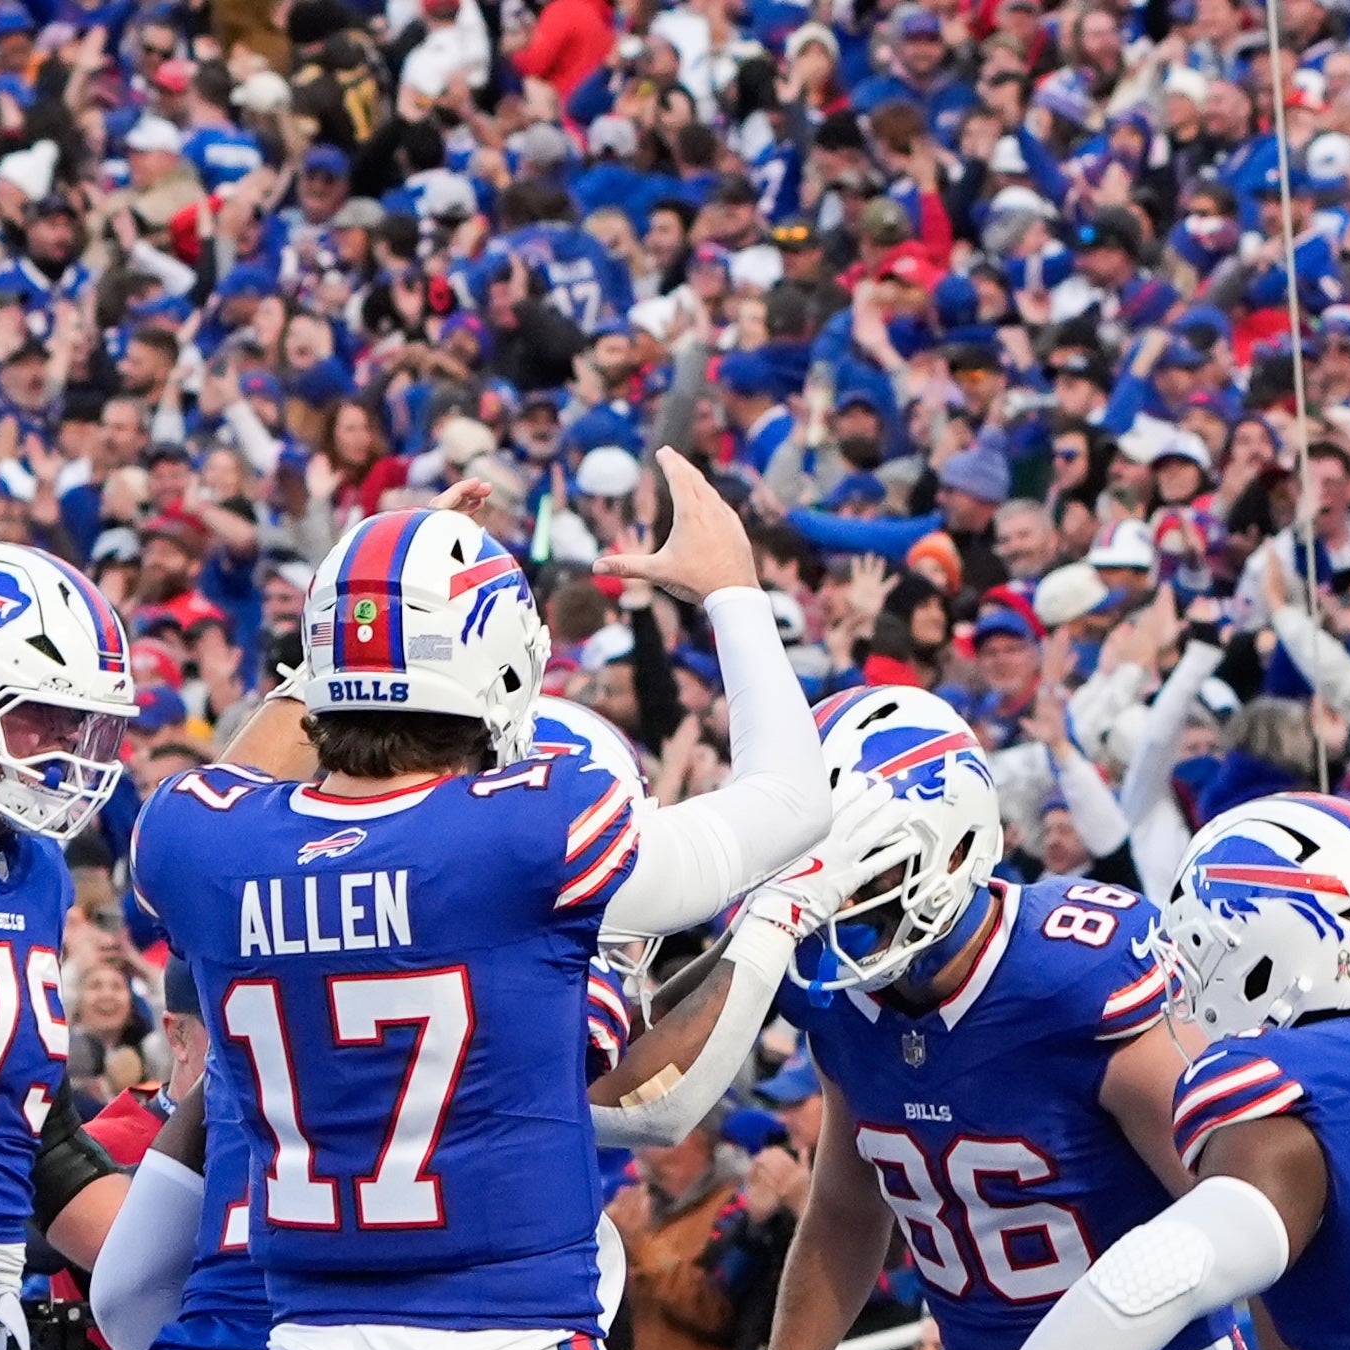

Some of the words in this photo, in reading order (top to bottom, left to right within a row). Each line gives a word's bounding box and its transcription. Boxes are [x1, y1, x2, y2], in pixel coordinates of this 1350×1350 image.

[329, 681, 410, 703] BILLS
[240, 869, 412, 957] ALLEN
[1041, 882, 1141, 948] 86
[221, 963, 478, 1232] 17
[904, 1102, 953, 1122] BILLS
[856, 1121, 1097, 1305] 86
